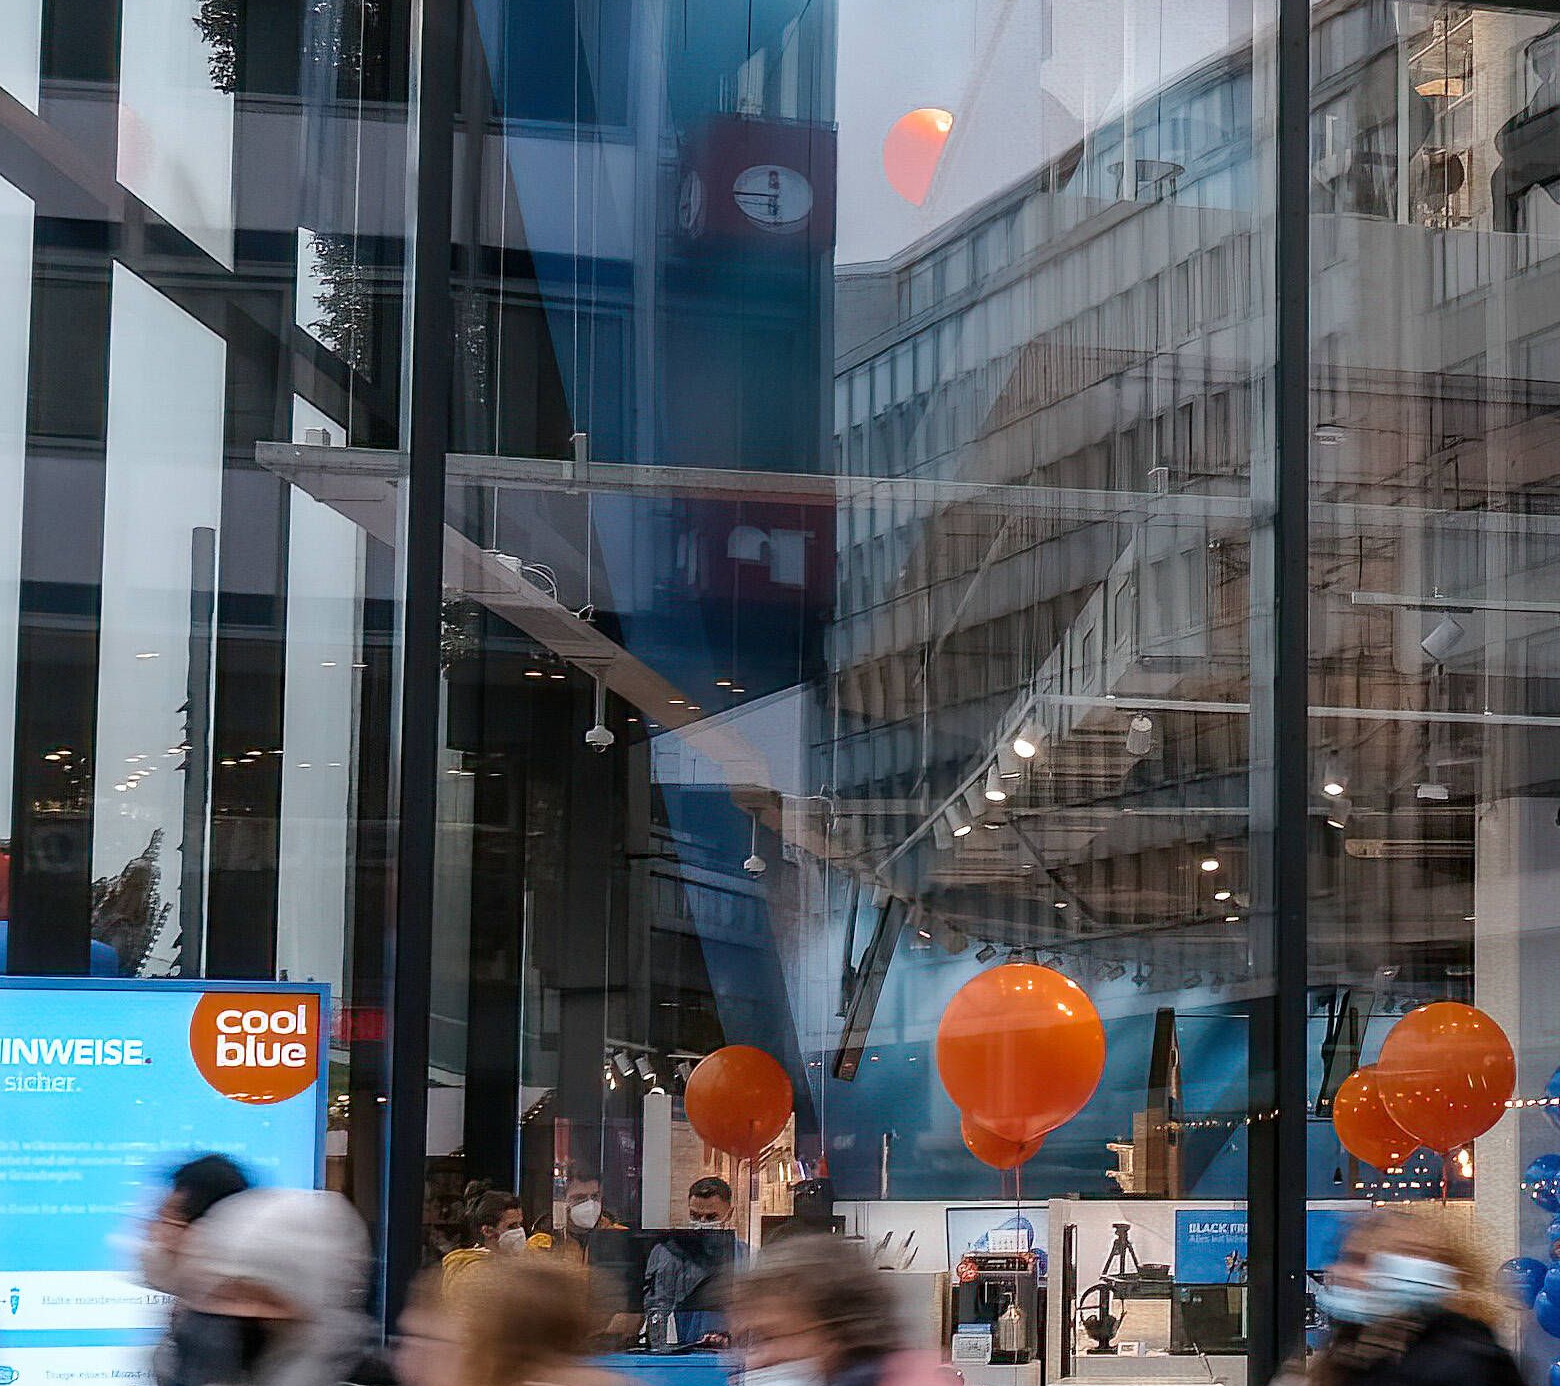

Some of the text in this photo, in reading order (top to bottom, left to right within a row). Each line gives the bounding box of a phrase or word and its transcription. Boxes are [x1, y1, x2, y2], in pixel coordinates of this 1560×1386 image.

[216, 1004, 307, 1035] cool
[216, 1035, 307, 1068] blue
[4, 1070, 82, 1093] sicher.
